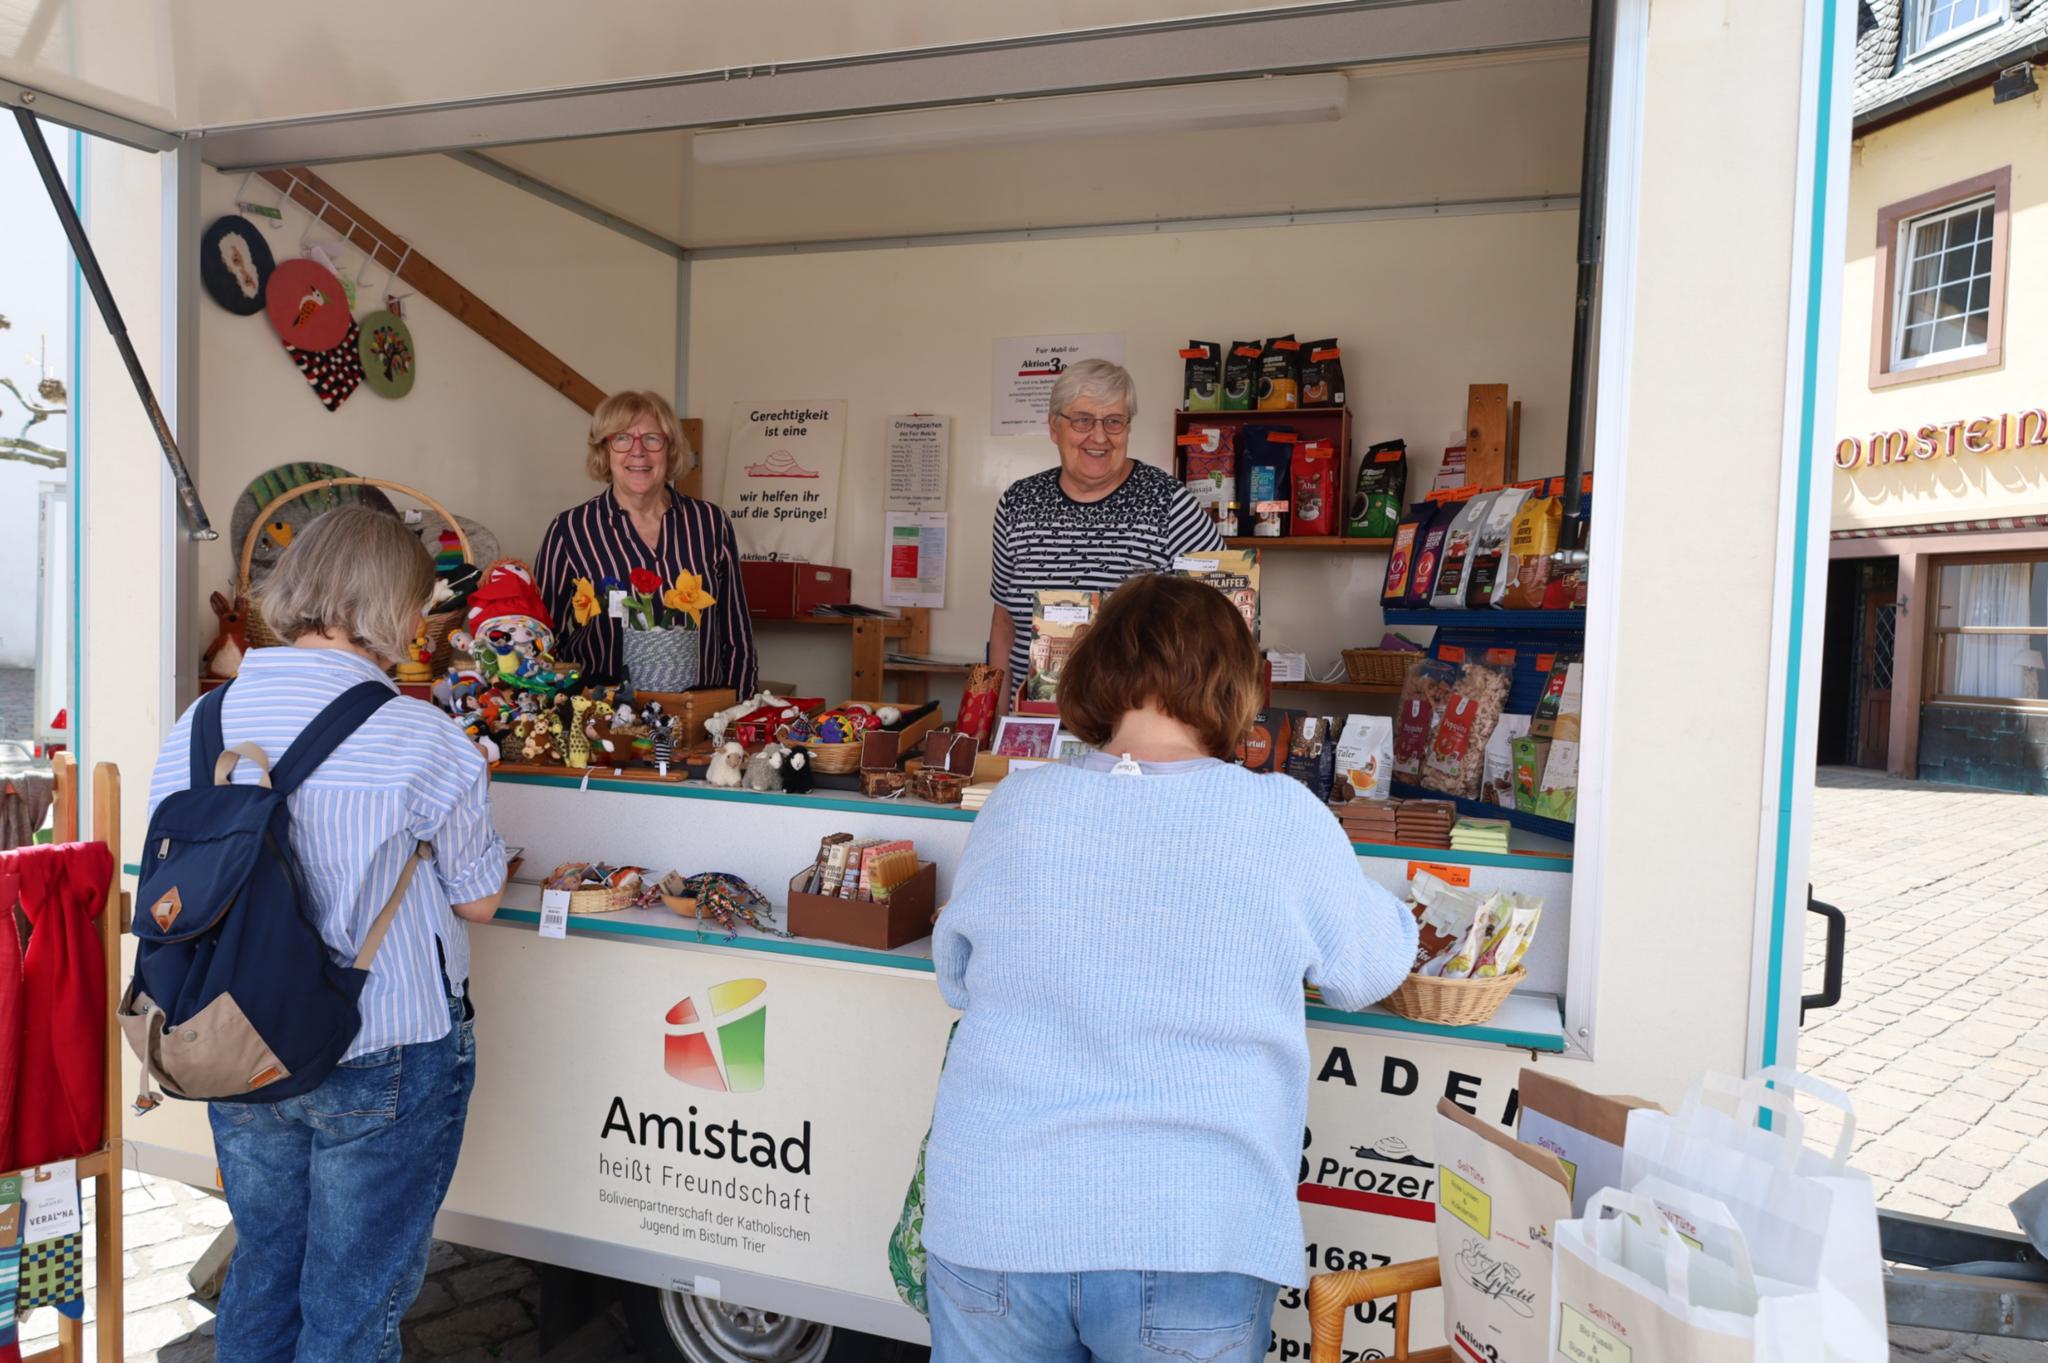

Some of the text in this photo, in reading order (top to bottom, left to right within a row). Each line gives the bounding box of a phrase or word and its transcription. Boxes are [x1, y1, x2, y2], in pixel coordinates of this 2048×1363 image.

[750, 409, 830, 424] Gerechtigkeit
[764, 425, 807, 437] ist eine
[740, 490, 820, 502] wir helfen ihr
[730, 507, 828, 523] auf die Sprünge!
[600, 1096, 812, 1175] Amistad
[599, 1152, 811, 1214] heißt Freundschaft
[599, 1188, 811, 1243] Bolivienpartnerschaft der Katholischen
[639, 1217, 766, 1253] Jugend im Bistum Trier
[1456, 1320, 1485, 1354] Aktion
